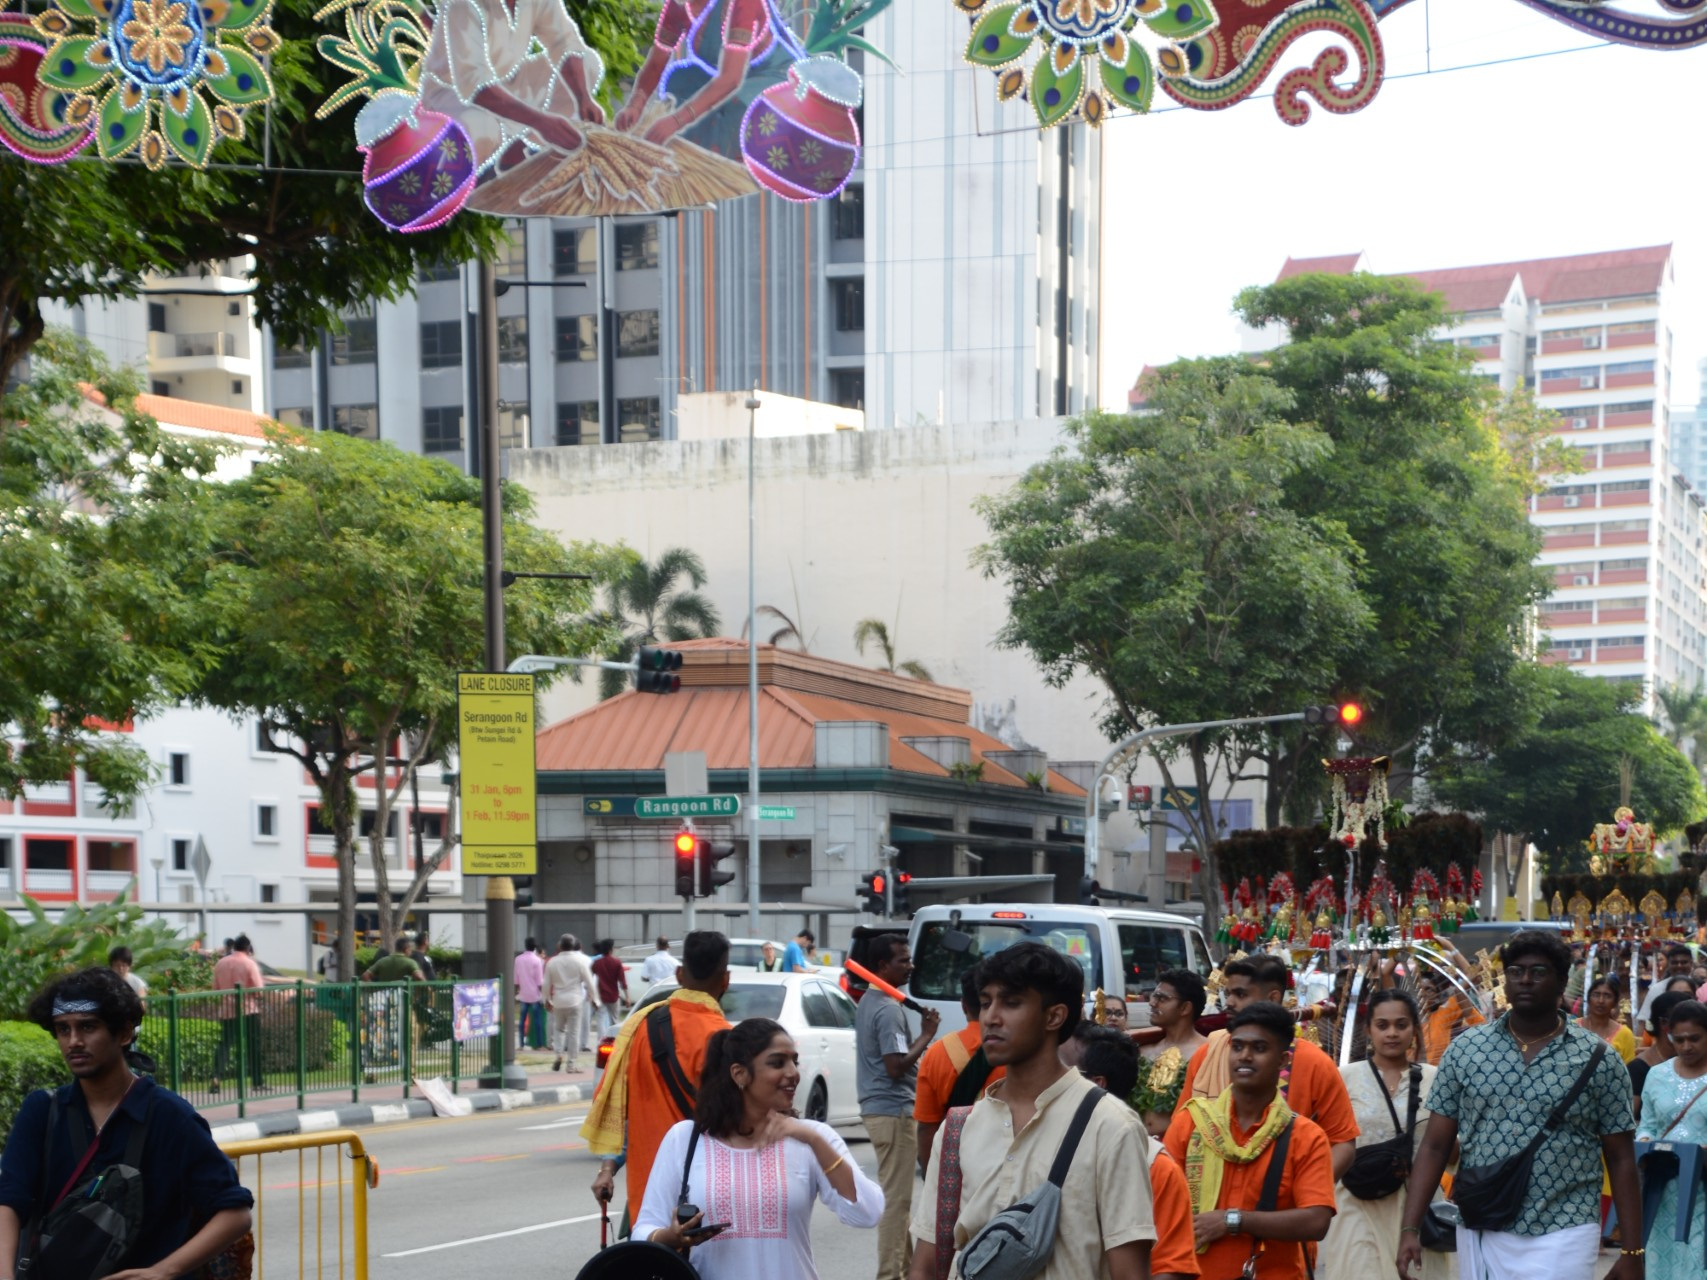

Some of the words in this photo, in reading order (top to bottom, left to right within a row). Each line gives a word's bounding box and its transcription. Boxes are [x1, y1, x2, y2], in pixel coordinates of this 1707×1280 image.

[461, 677, 485, 691] LANE
[488, 677, 531, 691] CLOSURE
[464, 711, 512, 725] Serangoon
[515, 711, 528, 723] Rd
[485, 726, 506, 736] Sungei
[507, 726, 516, 734] Rd
[498, 735, 516, 744] Road)
[470, 784, 480, 794] 31
[483, 784, 501, 796] Jan,
[503, 784, 523, 796] 6pm
[493, 798, 503, 808] to
[643, 799, 708, 815] Rangoon
[713, 798, 731, 811] Rd
[473, 811, 491, 822] Feb,
